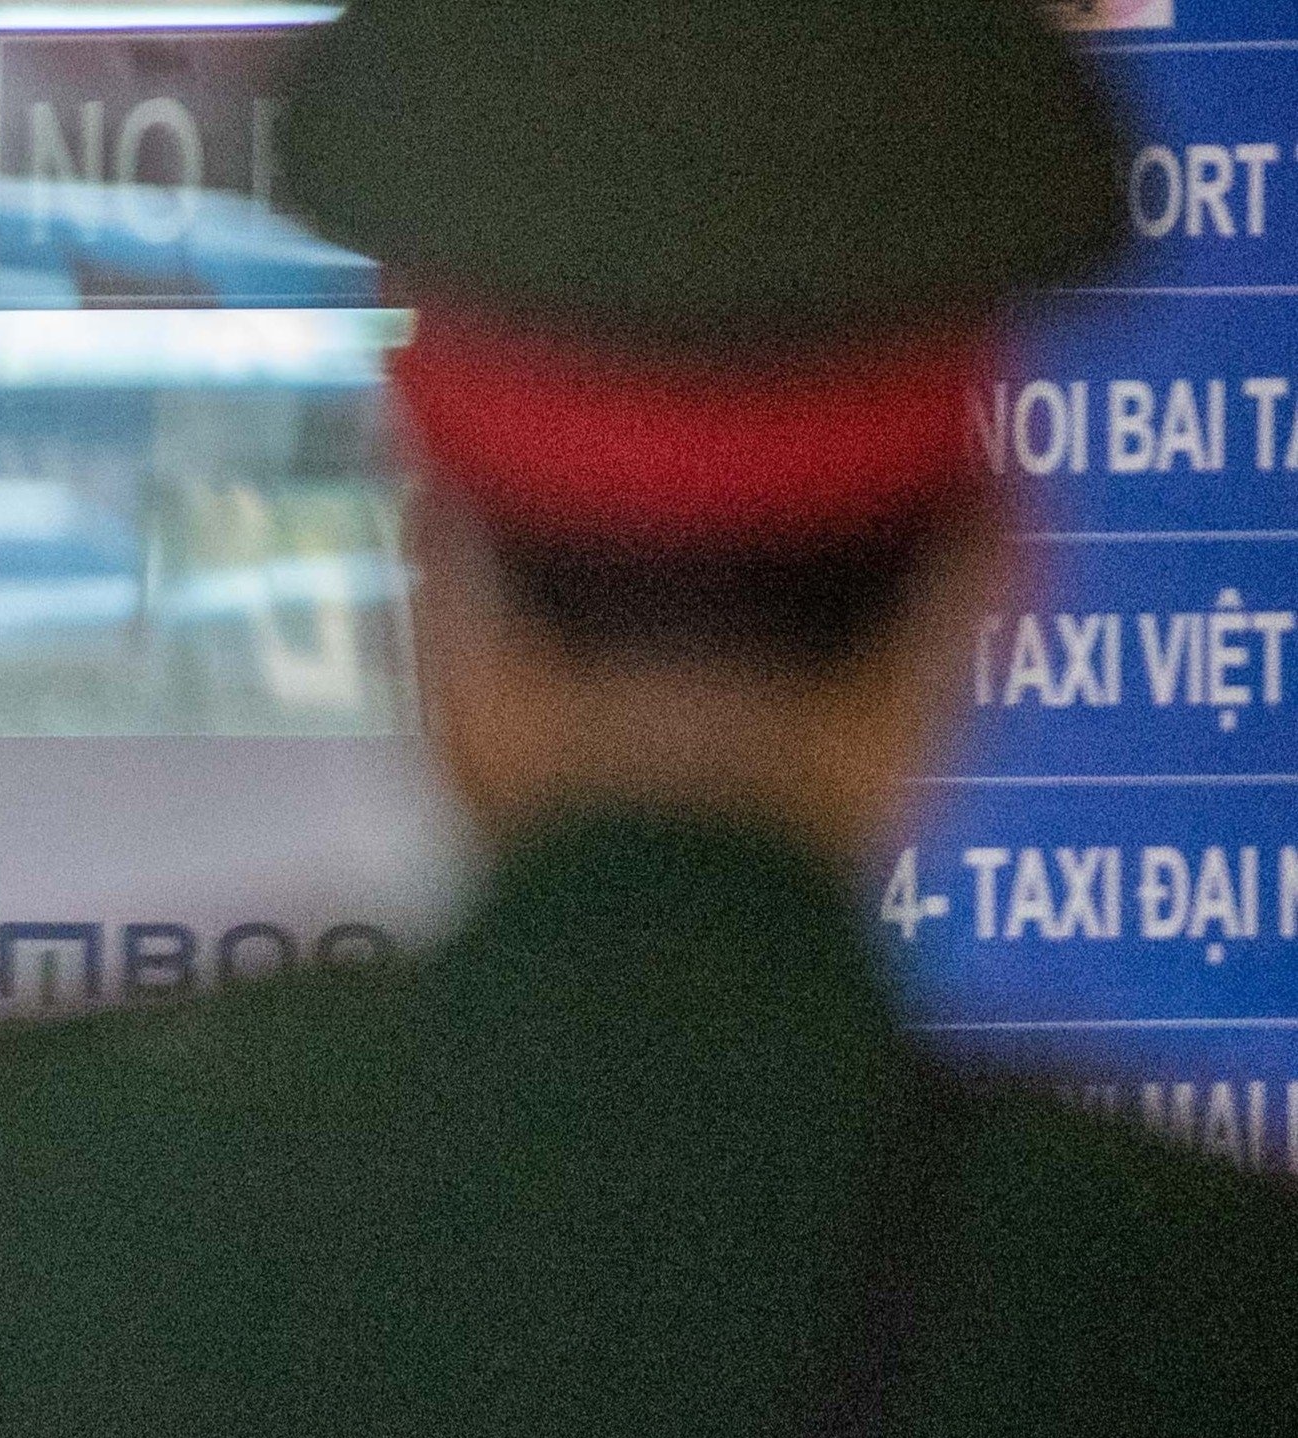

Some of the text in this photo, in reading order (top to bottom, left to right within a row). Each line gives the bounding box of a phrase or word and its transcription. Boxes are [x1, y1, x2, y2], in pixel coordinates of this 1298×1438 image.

[31, 96, 203, 245] NO
[1129, 144, 1280, 238] ORT
[1109, 378, 1226, 474] BAI
[1241, 376, 1298, 471] T
[973, 587, 1294, 732] TAXI VIỆT
[963, 845, 1122, 940] TAXI
[1136, 845, 1261, 965] ĐẠI
